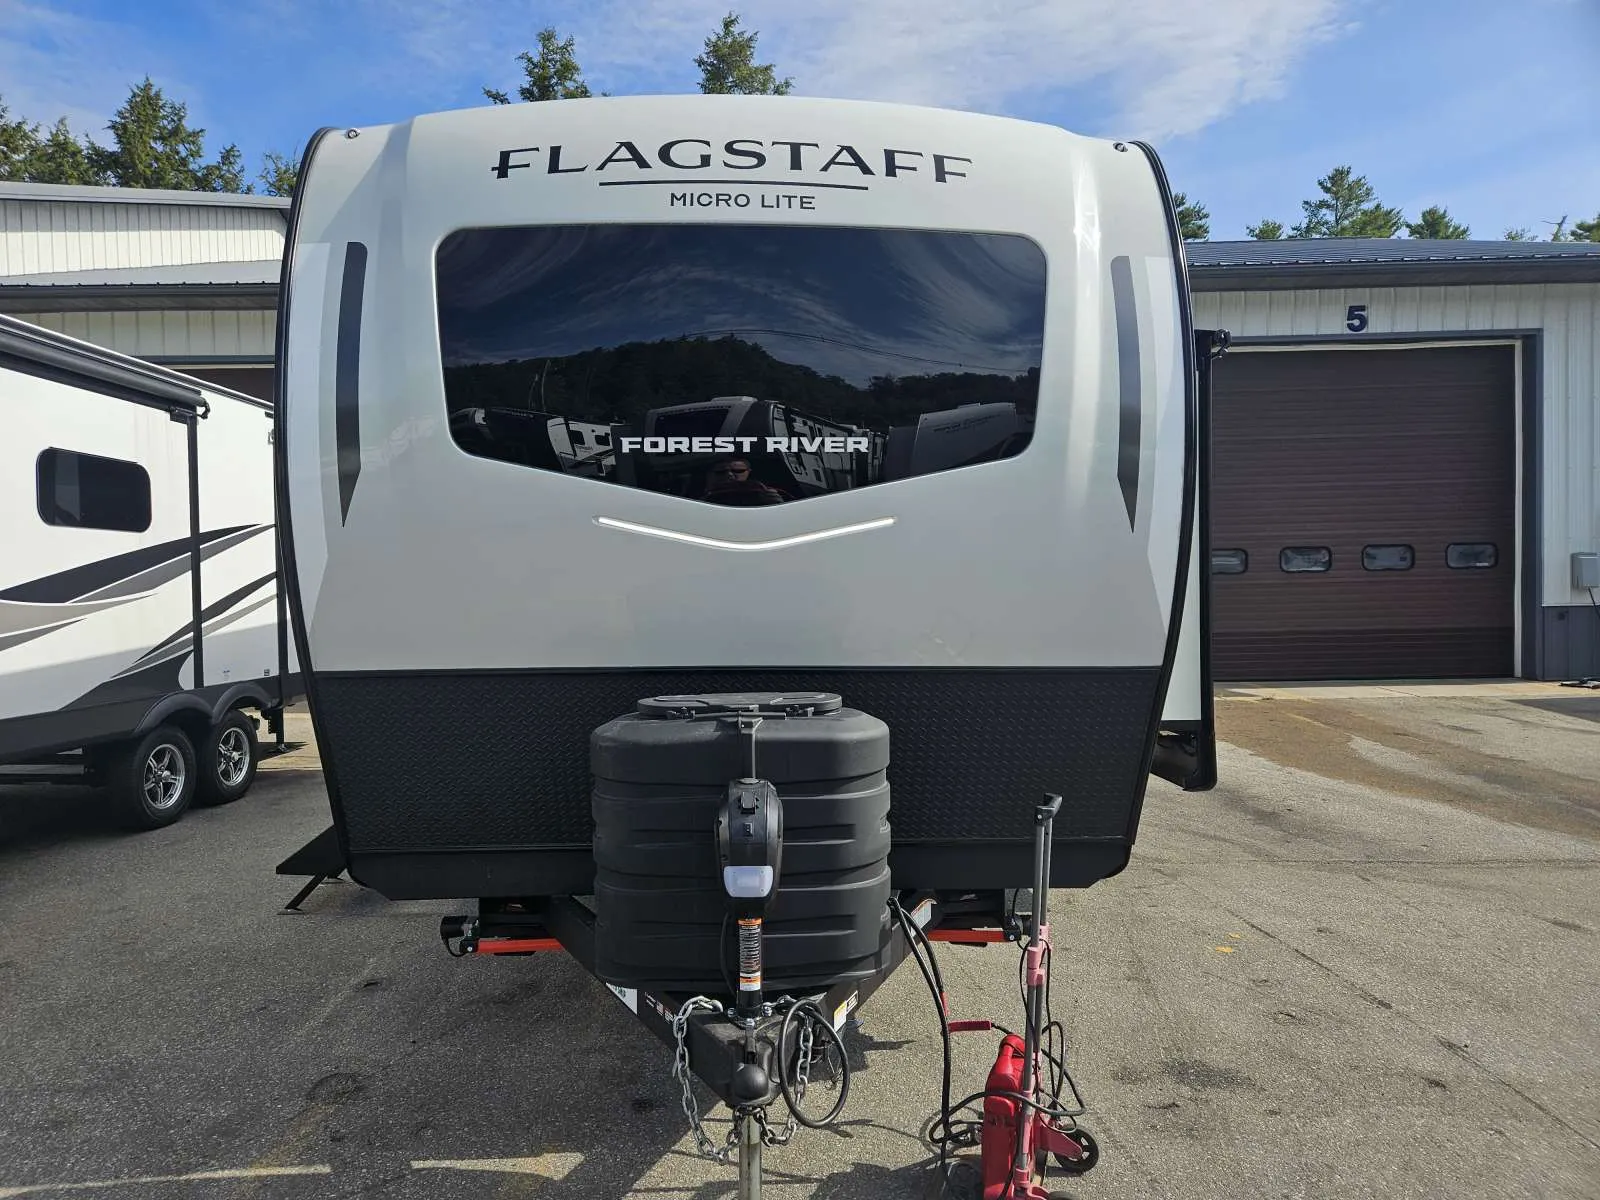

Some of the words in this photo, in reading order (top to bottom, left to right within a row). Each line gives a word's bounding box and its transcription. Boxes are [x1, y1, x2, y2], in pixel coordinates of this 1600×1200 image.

[491, 139, 973, 183] FLAGSTAFF
[670, 192, 751, 208] MICRO
[761, 194, 816, 210] LITE
[1346, 305, 1368, 332] 5
[620, 436, 758, 453] FOREST
[765, 436, 869, 453] RIVER
